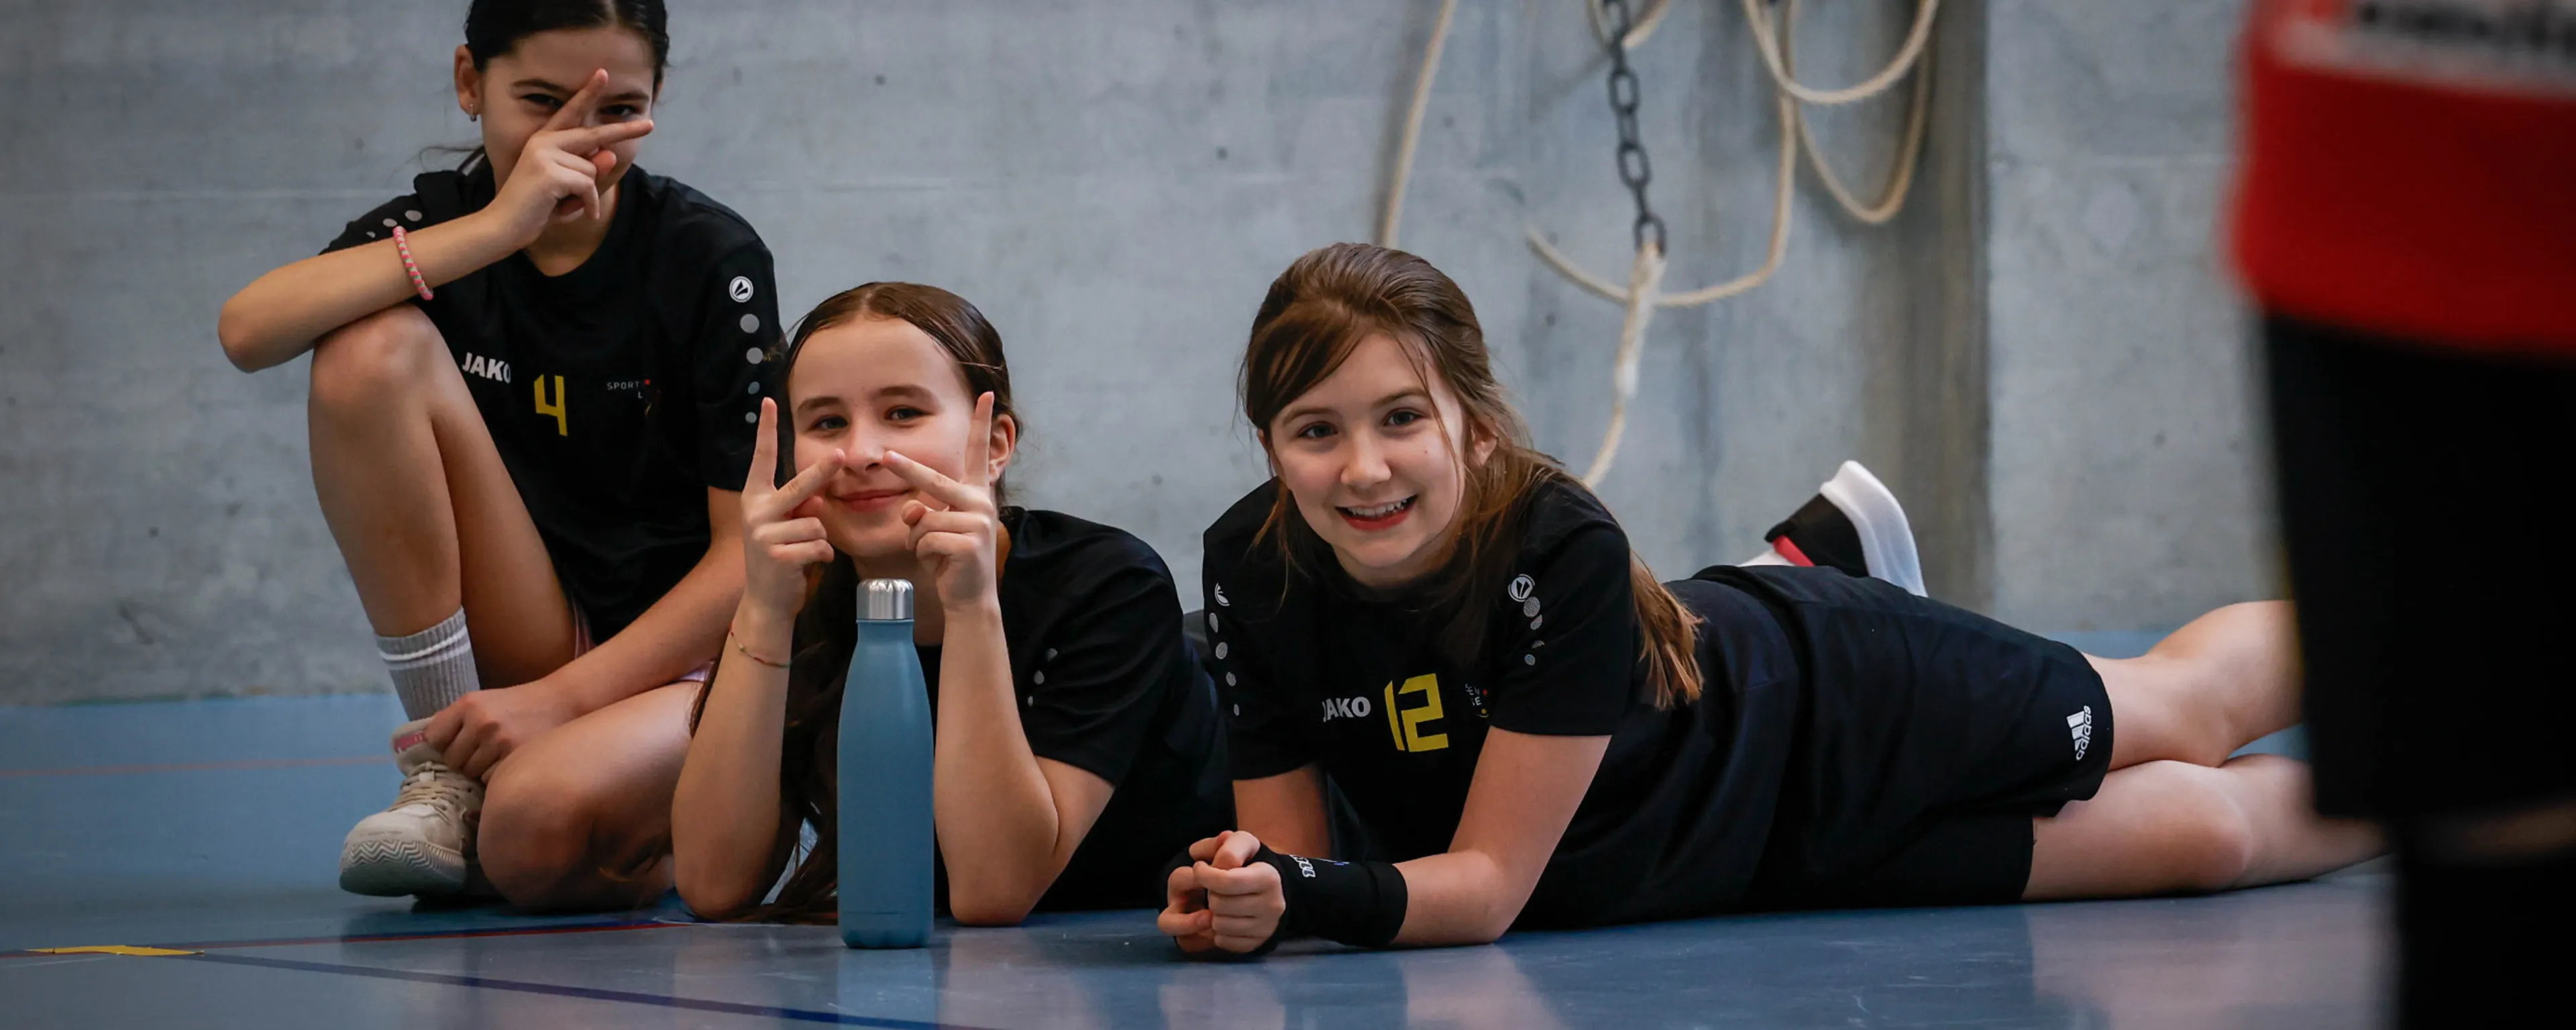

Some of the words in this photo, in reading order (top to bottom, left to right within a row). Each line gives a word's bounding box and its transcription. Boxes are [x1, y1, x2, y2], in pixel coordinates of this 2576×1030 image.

[462, 352, 511, 384] JAKO
[534, 374, 568, 436] 4
[1384, 673, 1449, 752] 12
[2076, 705, 2092, 761] adidas
